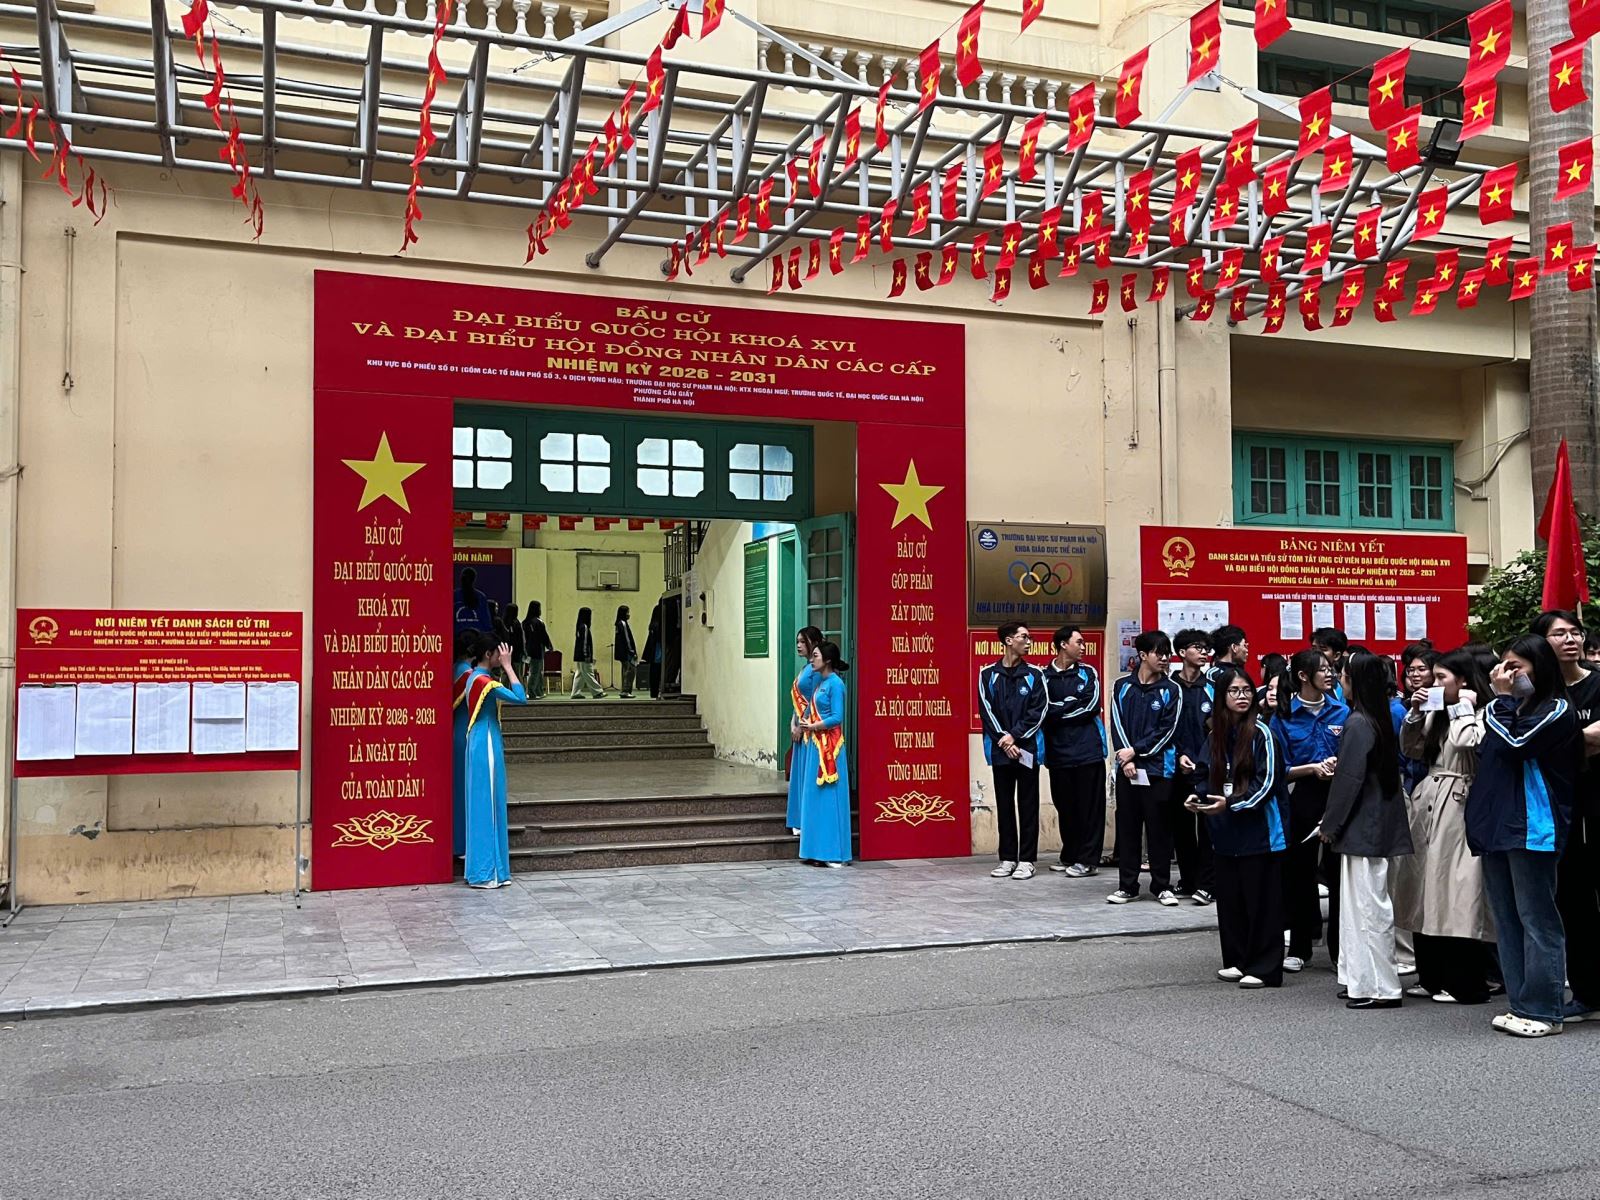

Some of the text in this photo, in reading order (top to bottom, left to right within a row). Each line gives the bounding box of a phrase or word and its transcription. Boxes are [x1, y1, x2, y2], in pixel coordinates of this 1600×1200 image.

[616, 306, 712, 324] BẦU CỬ
[452, 310, 505, 326] ĐẠI
[515, 312, 582, 332] BIỂU
[590, 322, 665, 339] QUỐC
[673, 327, 721, 344] HỘI
[811, 340, 856, 352] XVI
[352, 322, 938, 376] VÀ ĐẠI BIỂU HỘI ĐỒNG NHÂN DÂN CÁC CẤP
[414, 362, 436, 370] PHIẾU
[438, 364, 448, 372] SỐ
[482, 367, 498, 375] CÁC
[510, 369, 525, 377] DÂN
[569, 374, 586, 382] DỊCH
[626, 378, 652, 386] TRƯỜNG
[547, 356, 618, 374] NHIỆM
[626, 362, 650, 376] KỲ
[659, 366, 708, 380] 2026
[730, 370, 776, 384] 2031
[634, 388, 662, 396] PHƯỜNG
[678, 390, 694, 398] GIẤY
[365, 516, 404, 545] BẦU CỬ
[471, 552, 493, 562] NĂM!
[897, 533, 928, 558] BẦU CỬ
[1280, 537, 1386, 552] BẢNG NIÊM YẾT
[334, 550, 434, 586] ĐẠI BIỂU QUỐC HỘI
[1225, 564, 1234, 572] VÀ
[1236, 565, 1248, 574] ĐẠI
[1250, 563, 1265, 572] BIỂU
[1267, 565, 1278, 574] HỘI
[1280, 564, 1299, 573] ĐỒNG
[1300, 566, 1320, 574] NHÂN
[1322, 566, 1335, 574] DÂN
[1337, 566, 1350, 574] CÁC
[1352, 566, 1365, 575] CẤP
[1367, 568, 1388, 576] NHIỆM
[1390, 568, 1398, 576] KỲ
[1230, 552, 1248, 561] SÁCH
[1261, 552, 1276, 562] TIỂU
[1278, 554, 1288, 562] SỬ
[1304, 554, 1316, 562] TẮT
[1361, 558, 1372, 566] ĐẠI
[1374, 556, 1388, 565] BIỂU
[1390, 556, 1408, 566] QUỐC
[1409, 558, 1420, 567] HỘI
[892, 565, 932, 590] GÓP PHẦN
[1298, 576, 1312, 584] CẦU
[1314, 576, 1328, 584] GIẤY
[1360, 577, 1374, 586] PHỐ
[1386, 578, 1396, 587] NỘI
[391, 599, 410, 616] XVI
[891, 600, 934, 626] XÂY DỰNG
[96, 616, 270, 628] NƠI NIÊM YẾT DANH SÁCH CỬ TRI
[324, 622, 442, 658] VÀ ĐẠI BIỂU HỘI ĐỒNG
[892, 632, 934, 652] NHÀ NƯỚC
[975, 641, 988, 656] NƠI
[990, 641, 1006, 656] NIÊ
[1028, 642, 1048, 656] DANH
[1086, 642, 1096, 656] TRI
[332, 662, 434, 689] NHÂN DÂN CÁC CẤP
[886, 660, 940, 686] PHÁP QUYỀN
[330, 701, 366, 731] NHIỆM
[368, 701, 384, 726] KỲ
[386, 708, 408, 725] 2026
[416, 708, 436, 724] 2031
[875, 692, 952, 720] XÃ HỘI CHỦ NGHĨA
[349, 736, 418, 766] LÀ NGÀY HỘI
[894, 726, 934, 752] VIỆT NAM
[888, 760, 910, 780] VỮNG
[342, 772, 363, 800] CỦA
[366, 774, 394, 798] TOÀN
